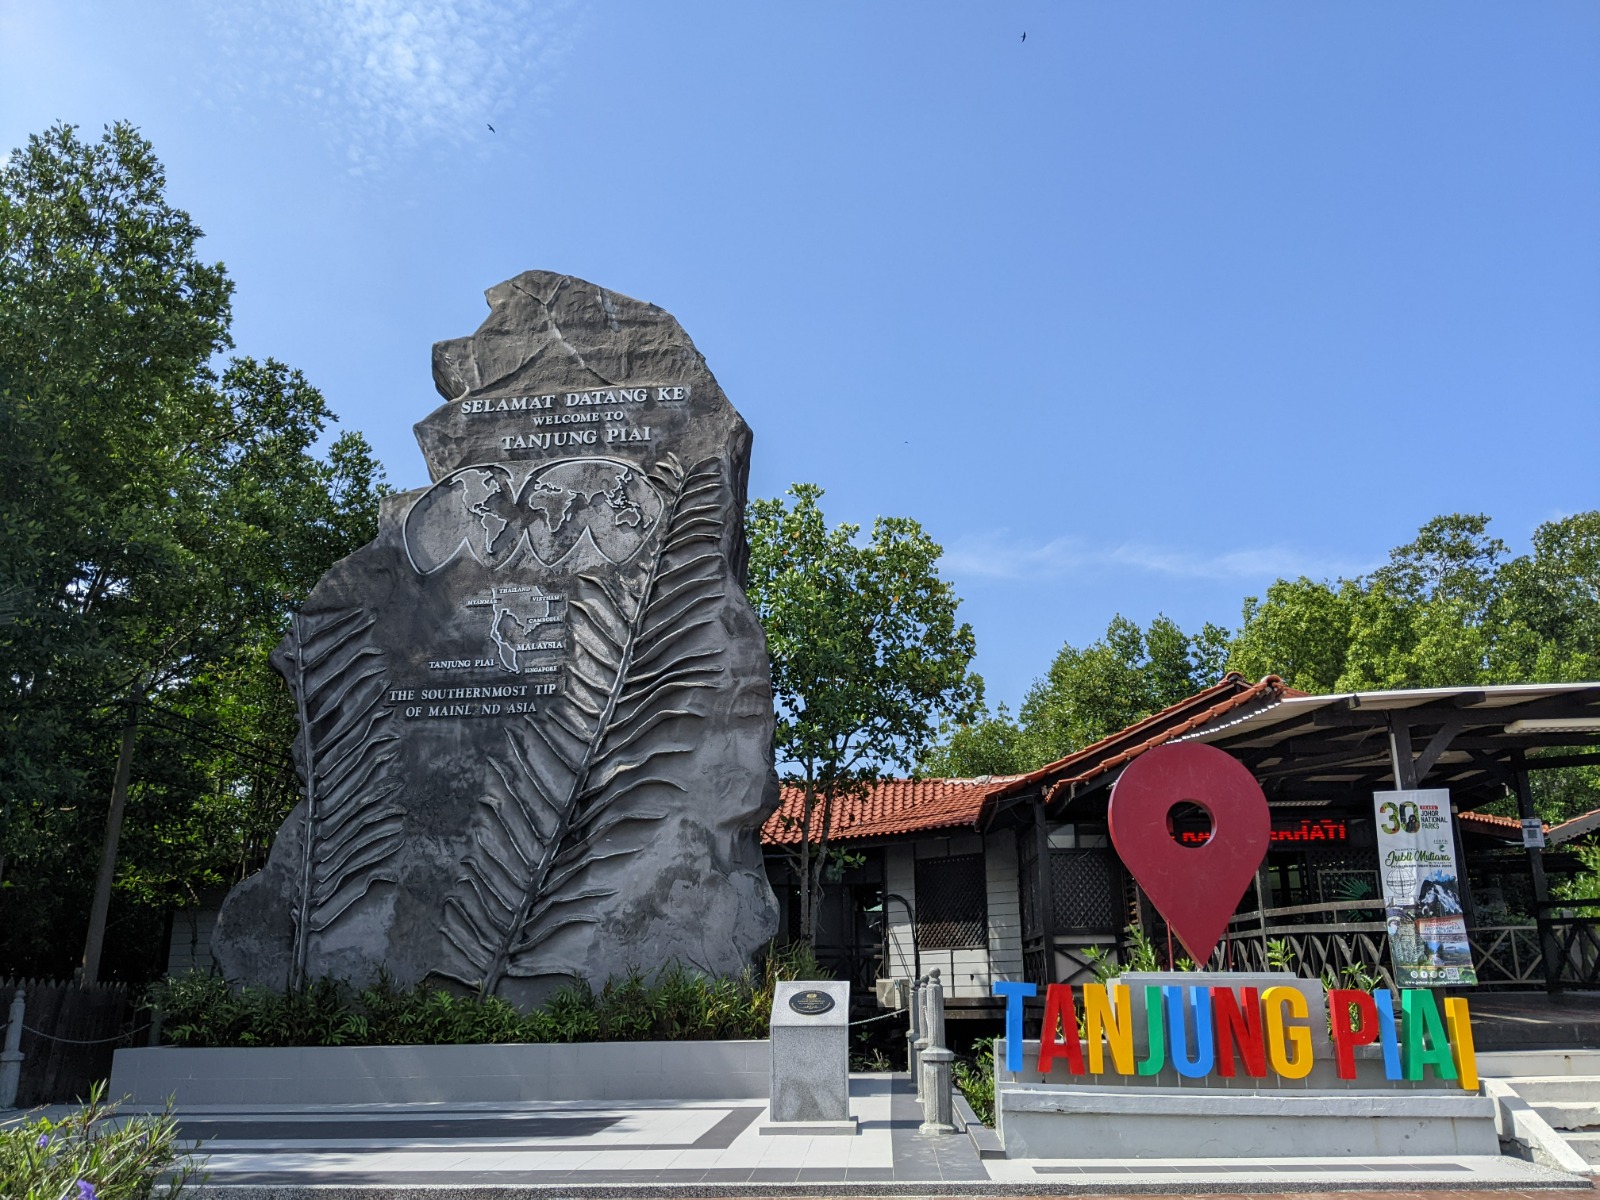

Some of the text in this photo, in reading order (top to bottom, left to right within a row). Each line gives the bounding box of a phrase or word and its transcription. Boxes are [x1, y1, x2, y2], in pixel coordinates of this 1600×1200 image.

[461, 386, 685, 414] SELAMAT DATANG KE
[533, 411, 624, 426] WELCOME TO
[501, 426, 652, 450] TANJUNG PIAI
[499, 586, 531, 594] THAILAND
[528, 616, 561, 624] CAMBODIA
[516, 641, 563, 651] MALAYSIA
[429, 660, 471, 669] TANJUNG
[389, 684, 557, 701] THE SOUTHERNMOST TIP
[405, 706, 423, 717] OF
[506, 702, 537, 714] ASIA
[1379, 801, 1421, 835] 30
[1385, 850, 1452, 866] Jubli Mutiara
[993, 981, 1480, 1090] TANJUNG PIAI
